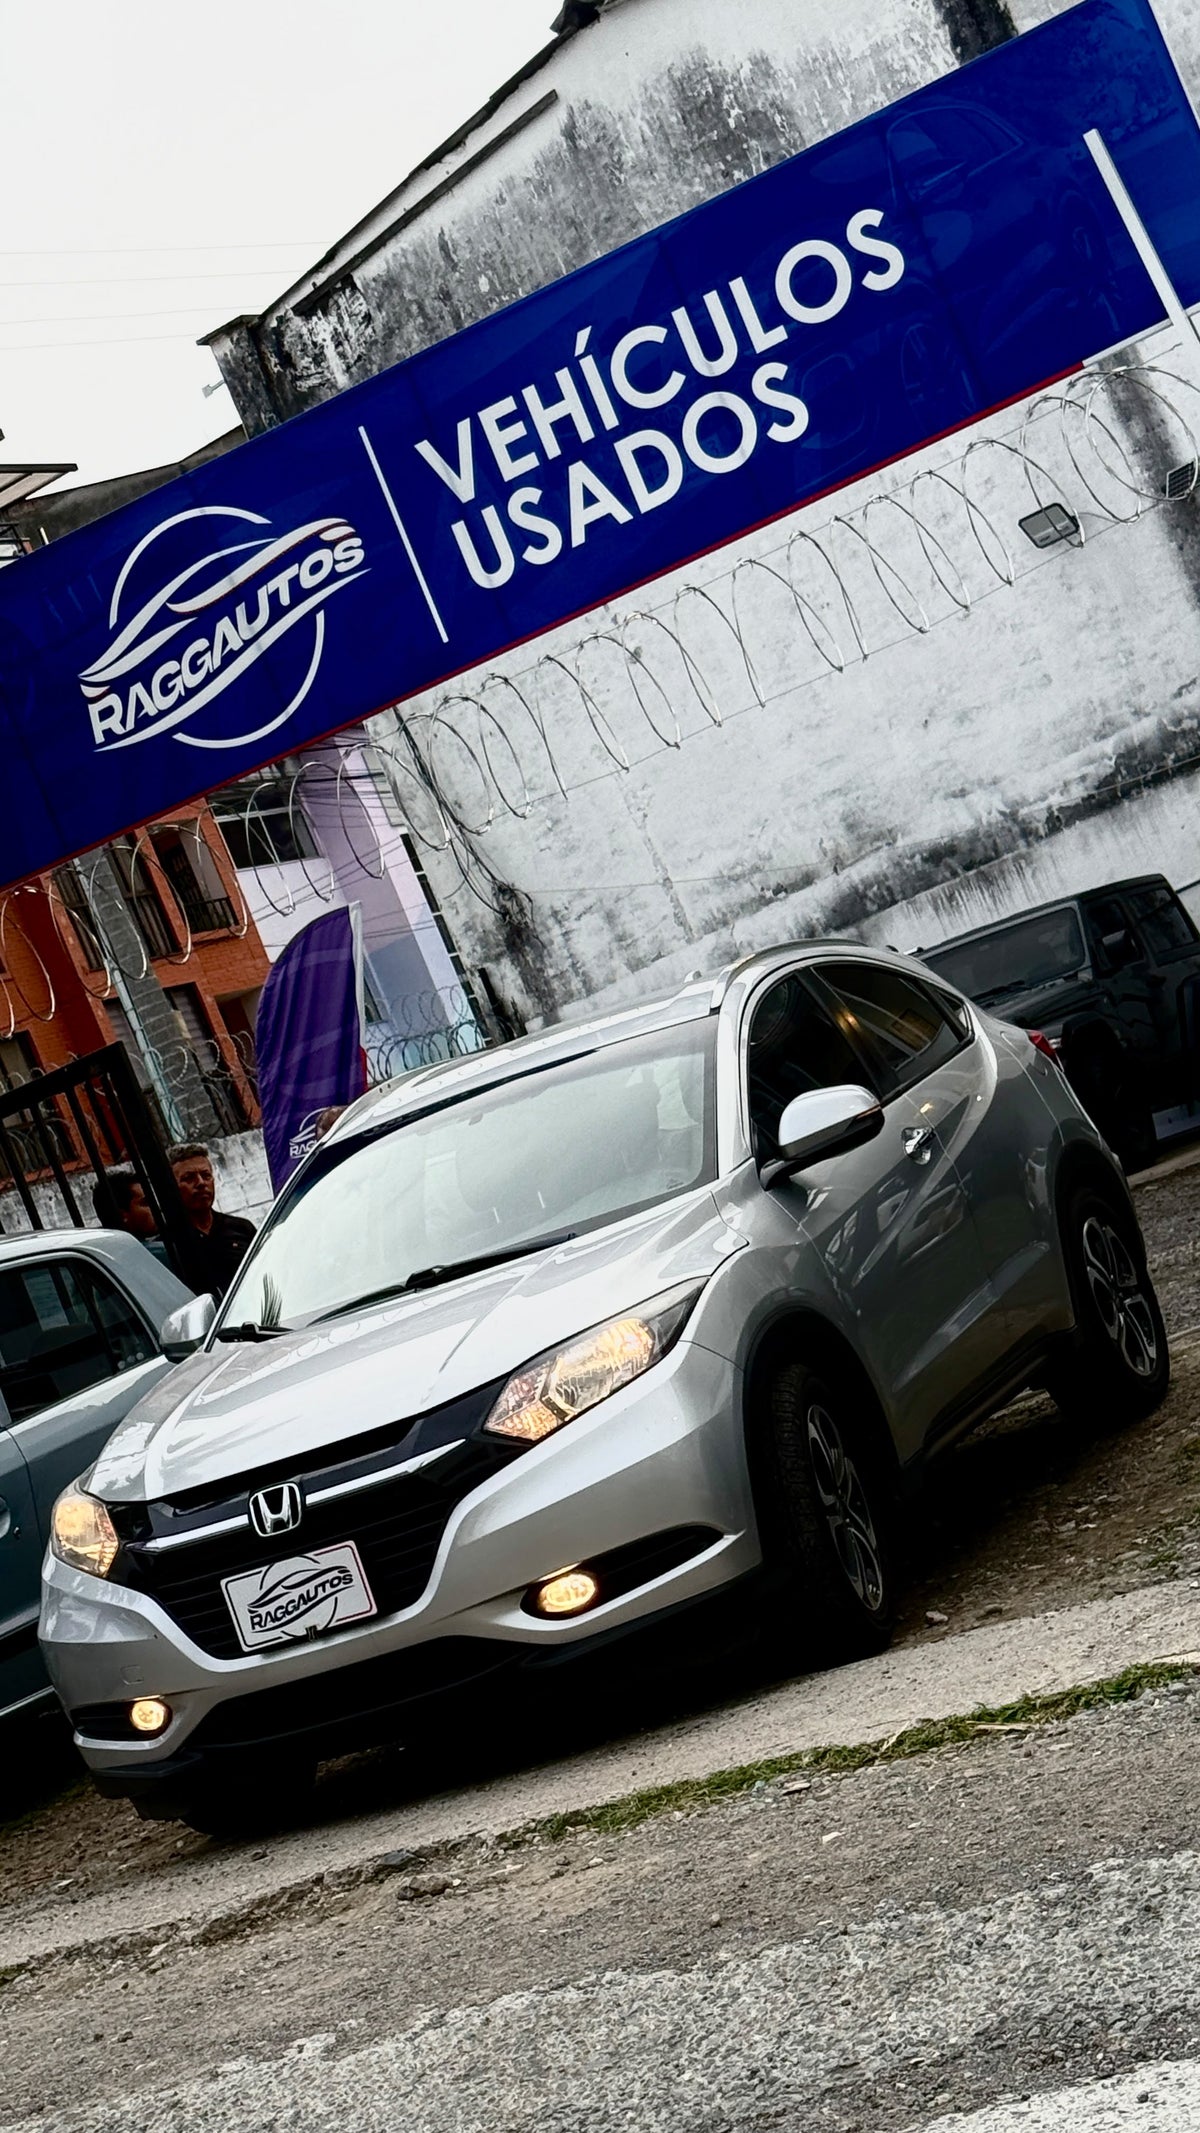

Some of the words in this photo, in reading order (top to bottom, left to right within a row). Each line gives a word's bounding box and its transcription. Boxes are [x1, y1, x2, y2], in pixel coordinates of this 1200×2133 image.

[414, 209, 905, 503] VEHÍCULOS
[451, 362, 809, 588] USADOS
[87, 536, 365, 745] RAGGAUTOS
[250, 1573, 354, 1631] RAGGAUTOS
